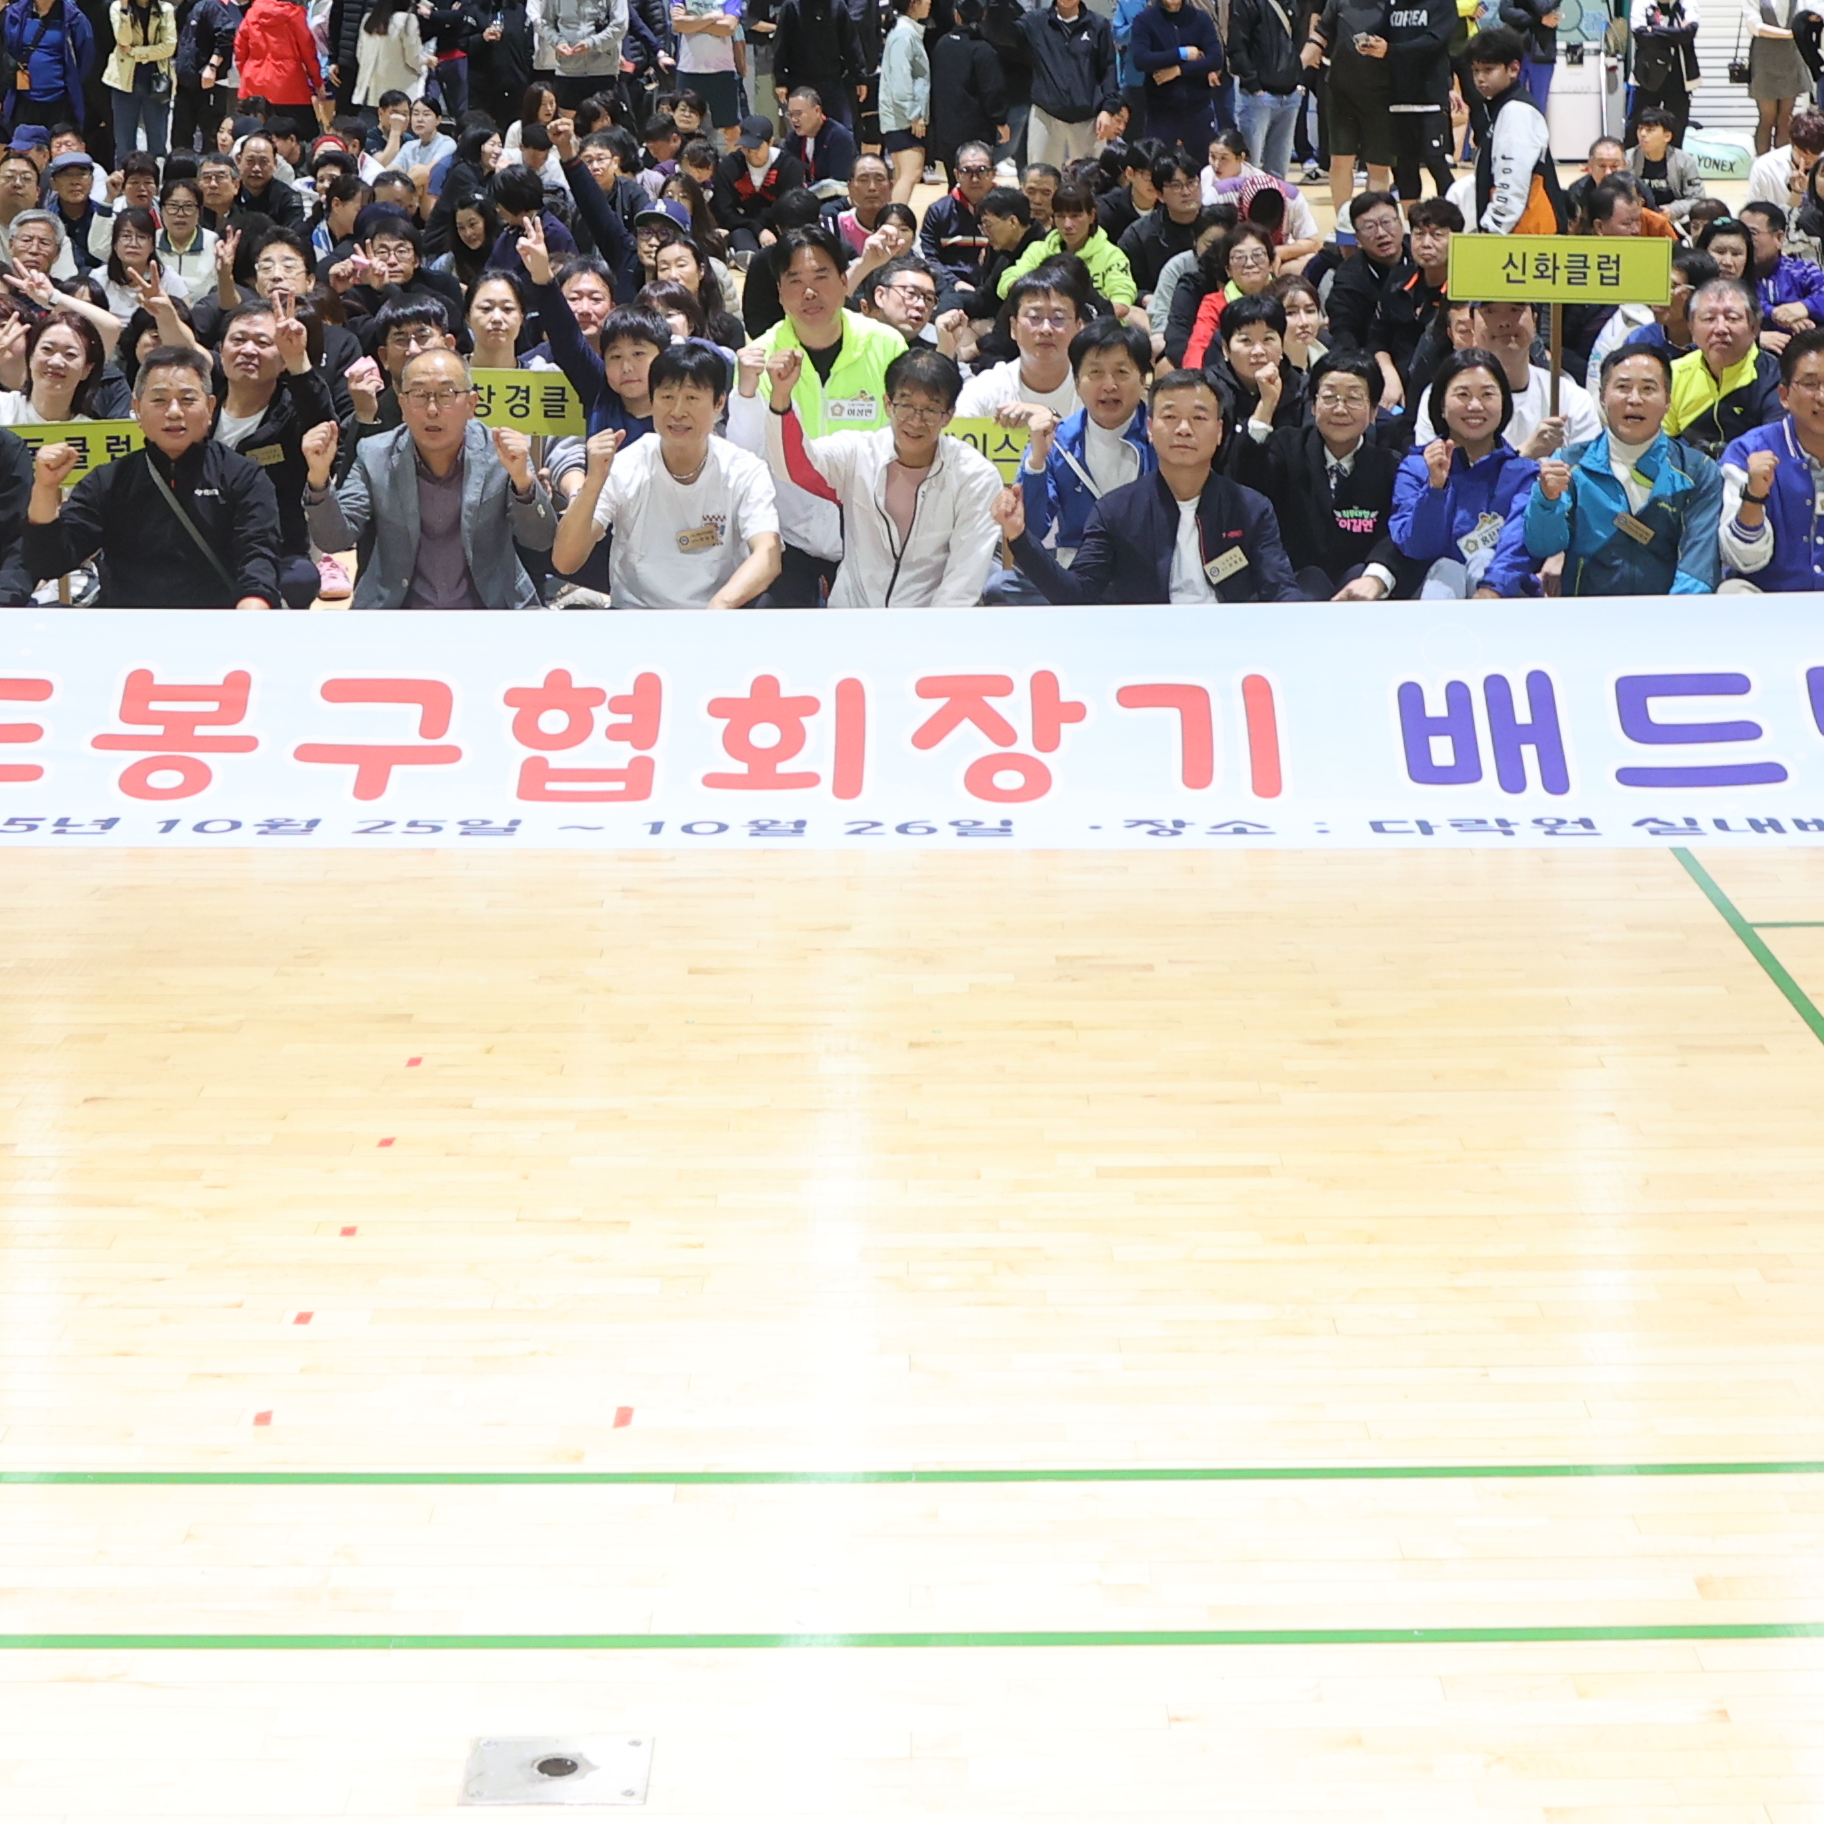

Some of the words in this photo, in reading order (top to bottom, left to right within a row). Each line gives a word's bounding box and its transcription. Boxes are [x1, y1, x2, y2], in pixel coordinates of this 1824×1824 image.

[1697, 156, 1737, 174] YONEX
[1500, 251, 1623, 288] 신화클럽
[472, 384, 587, 419] 창경클
[156, 818, 323, 837] 10월
[352, 819, 523, 836] 25일
[642, 820, 807, 838] 10월
[843, 819, 1014, 838] 26일
[1368, 816, 1604, 838] 다락원
